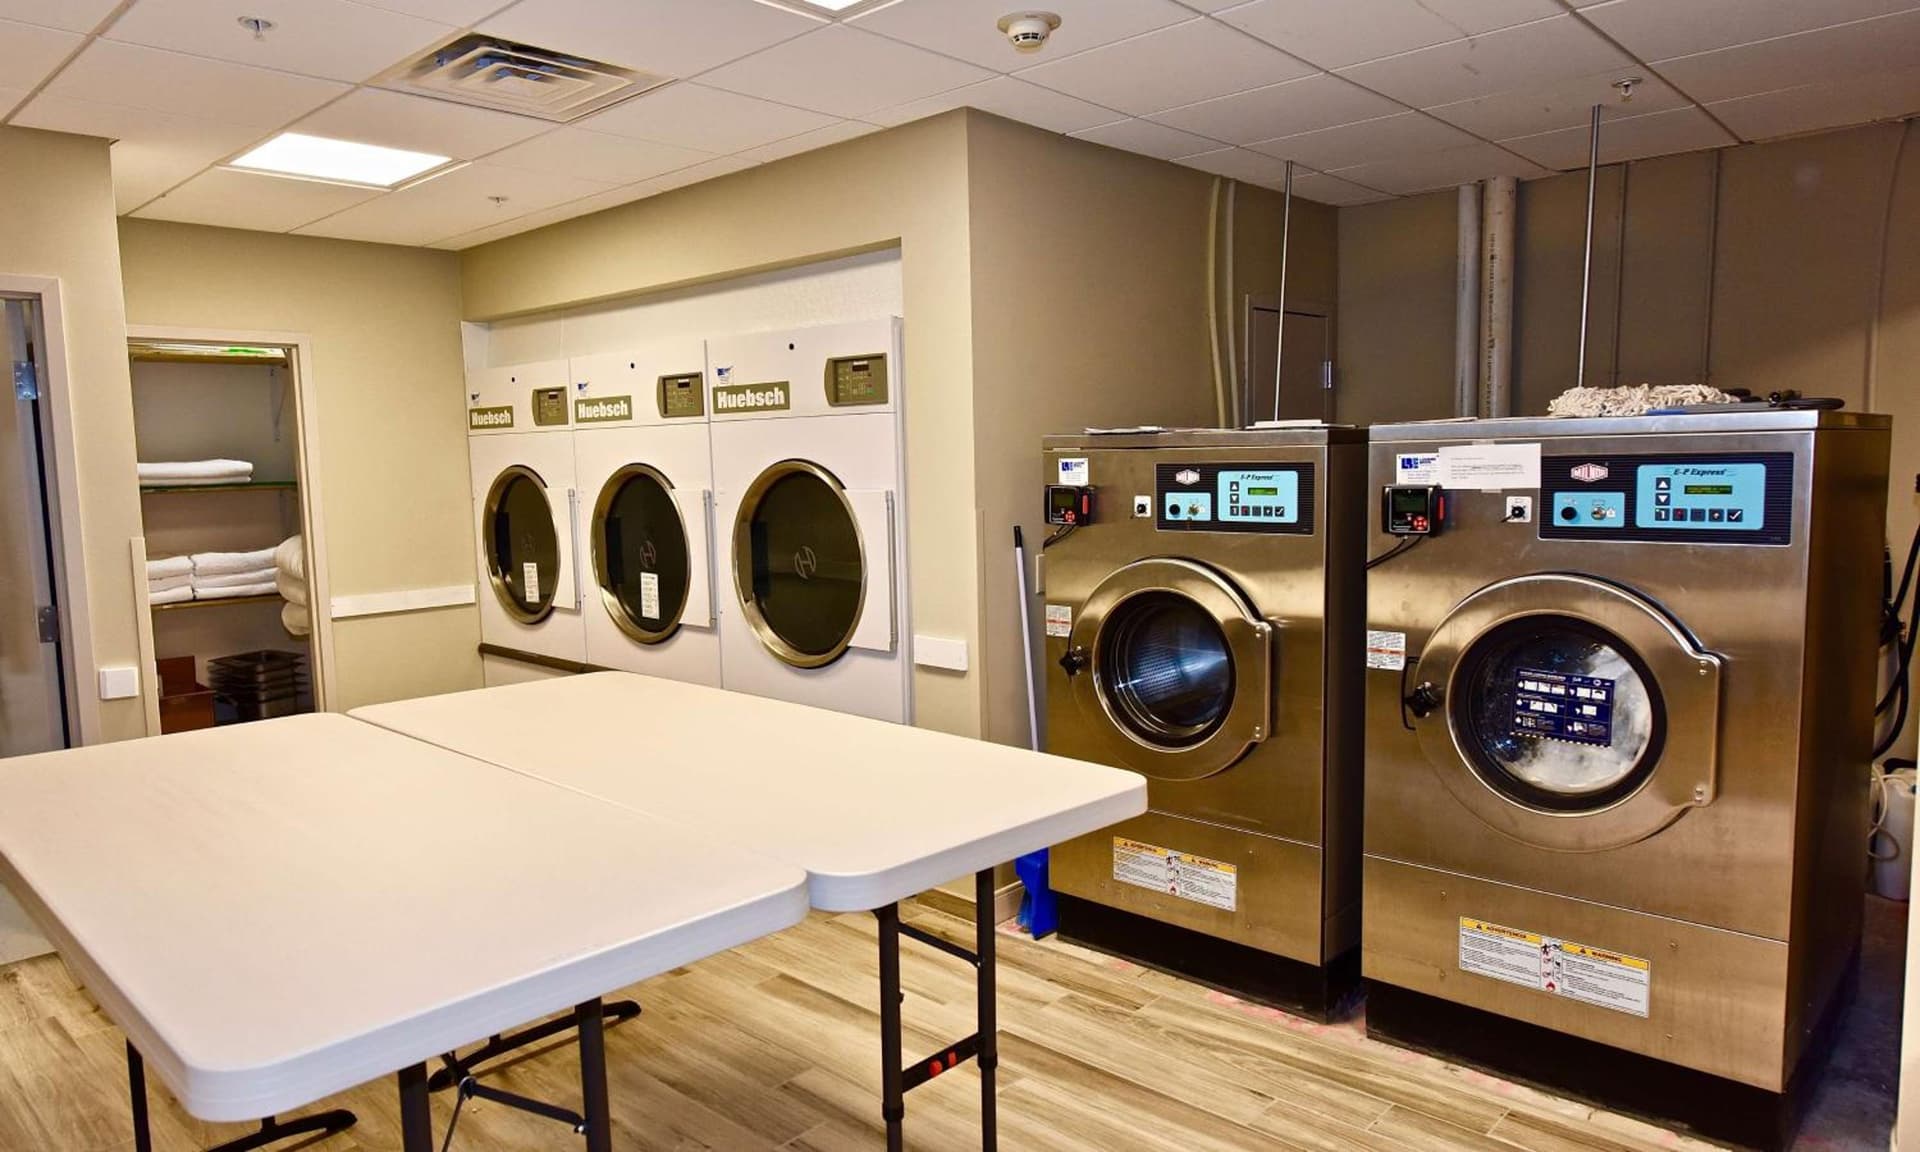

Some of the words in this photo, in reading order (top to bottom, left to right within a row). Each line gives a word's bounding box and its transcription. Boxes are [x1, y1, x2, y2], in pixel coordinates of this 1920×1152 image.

[717, 387, 785, 408] Huebsch
[471, 409, 511, 426] Huebsch
[578, 400, 628, 418] Huebsch
[1690, 468, 1724, 477] Express
